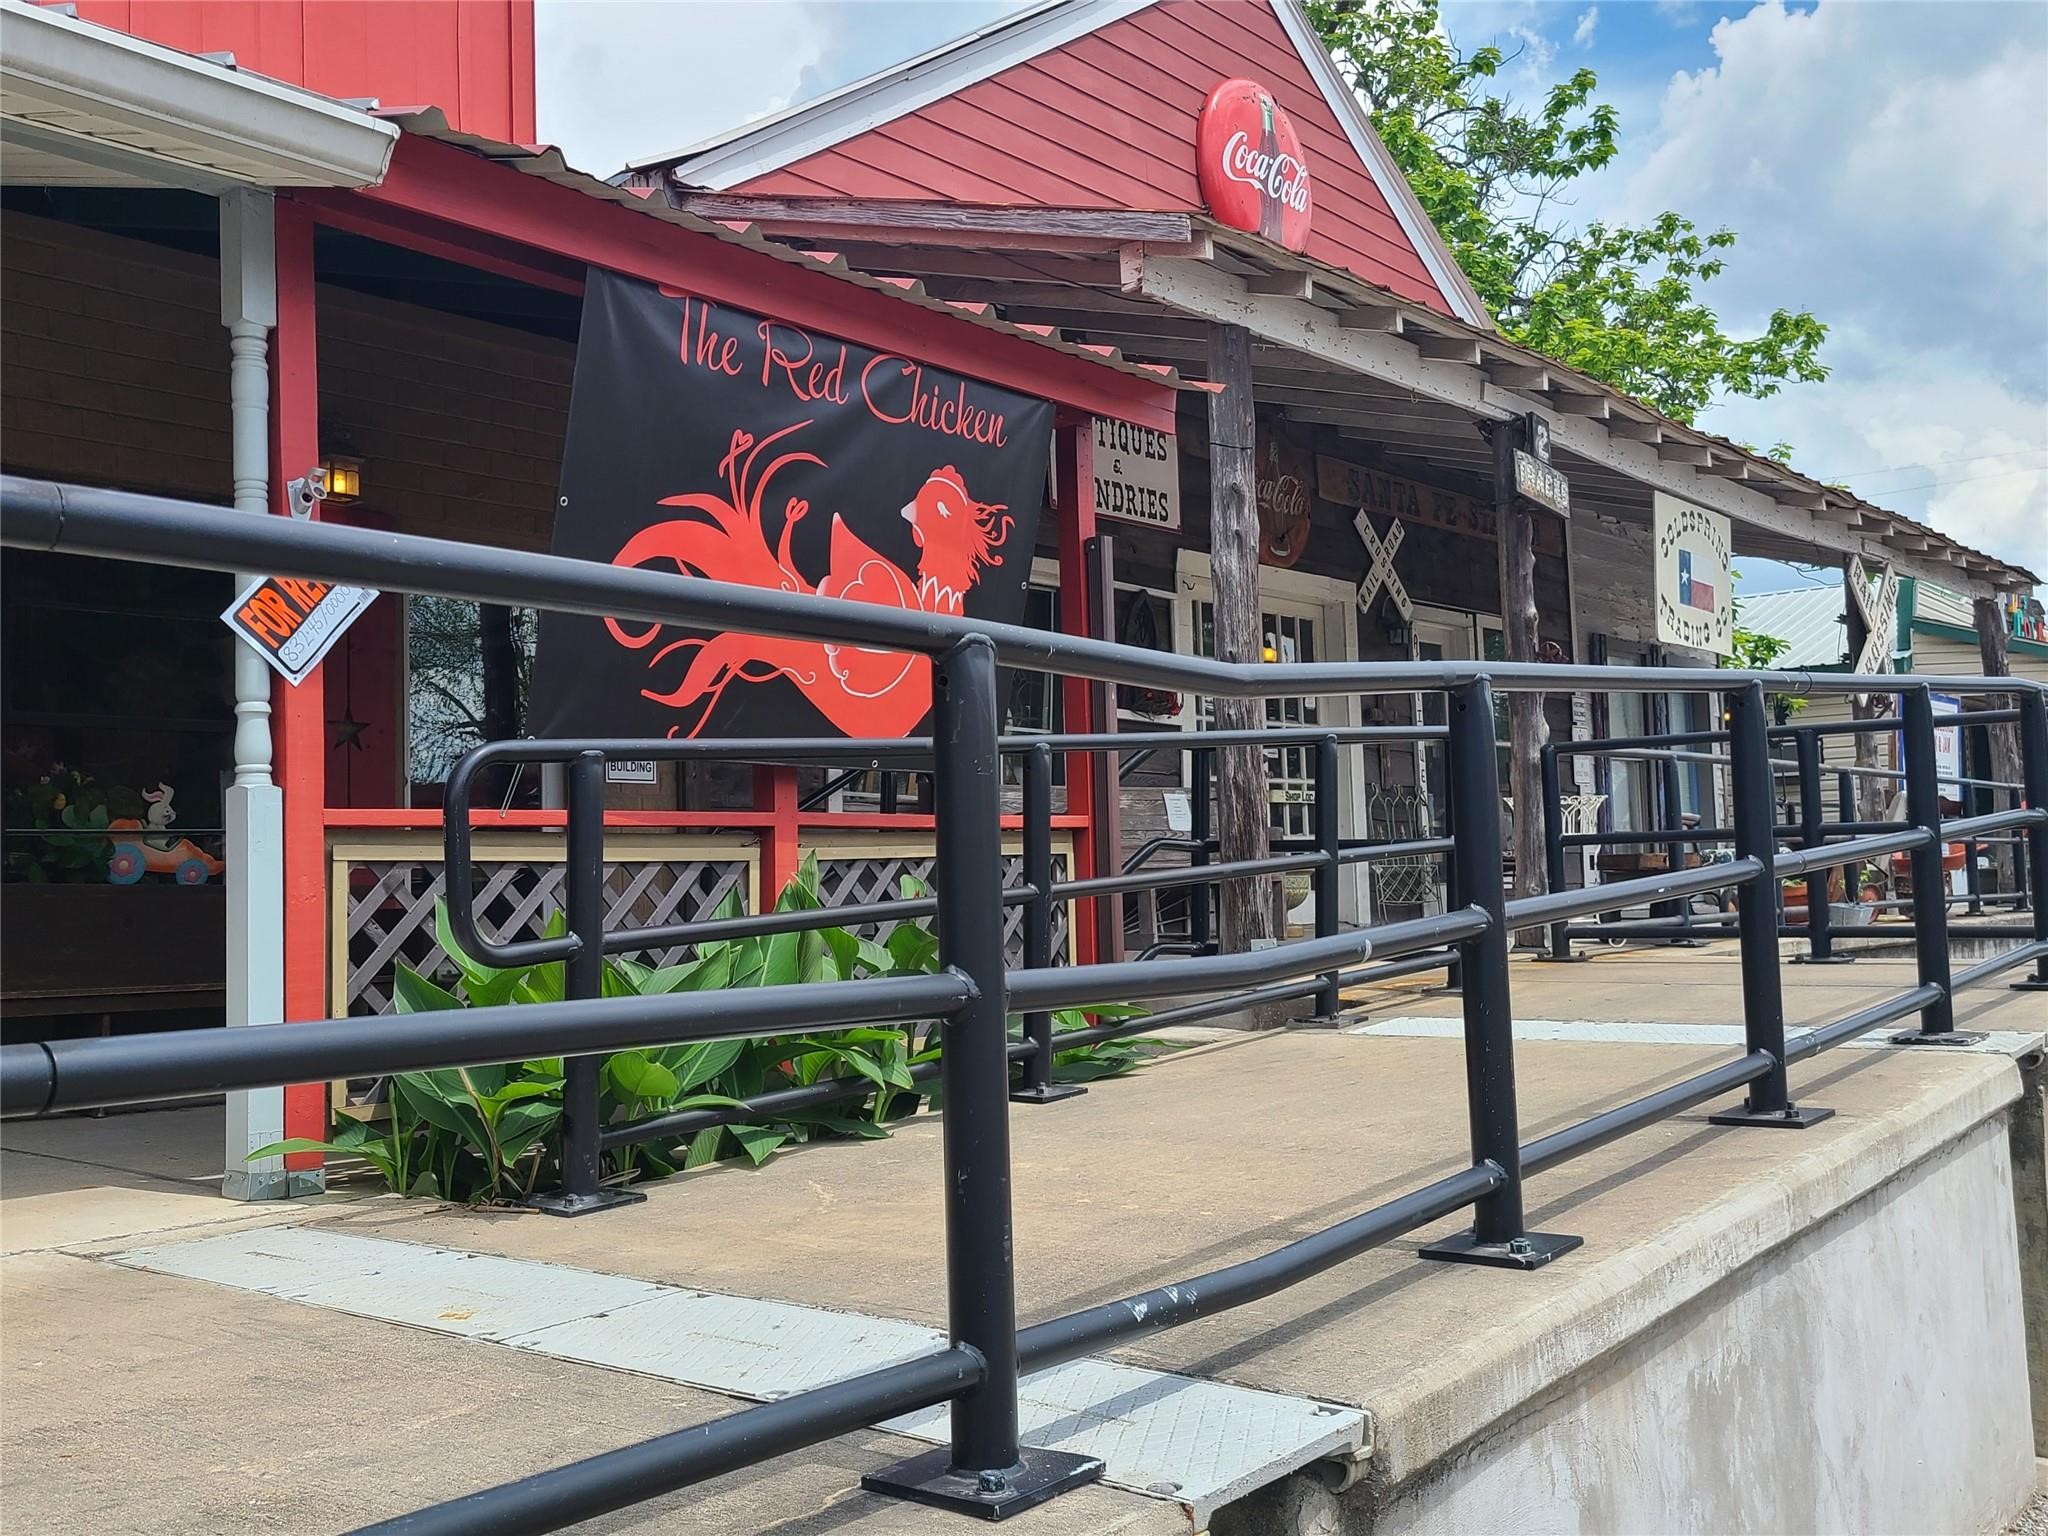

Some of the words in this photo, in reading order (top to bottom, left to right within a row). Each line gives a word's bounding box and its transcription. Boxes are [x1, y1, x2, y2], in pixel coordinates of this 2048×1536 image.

[1222, 131, 1308, 213] Coca-Cola
[656, 284, 743, 376] The
[757, 318, 850, 406] Red
[860, 352, 1008, 448] Chicken
[1094, 419, 1168, 461] TIQUES
[1112, 458, 1123, 475] &
[1537, 424, 1550, 461] 2
[1094, 477, 1169, 522] NDRIES
[1257, 475, 1306, 515] ca-Cola
[1347, 467, 1422, 518] SANTA
[1360, 572, 1379, 607] RAIL
[1383, 522, 1403, 560] ROAD
[1363, 523, 1408, 608] CROSSING
[1660, 510, 1729, 572] COLDSPRING
[238, 586, 303, 649] FOR
[1660, 593, 1710, 647] TRADING
[1852, 561, 1875, 622] RAIL
[1862, 575, 1897, 675] ROSSING
[610, 760, 652, 773] BUILDING
